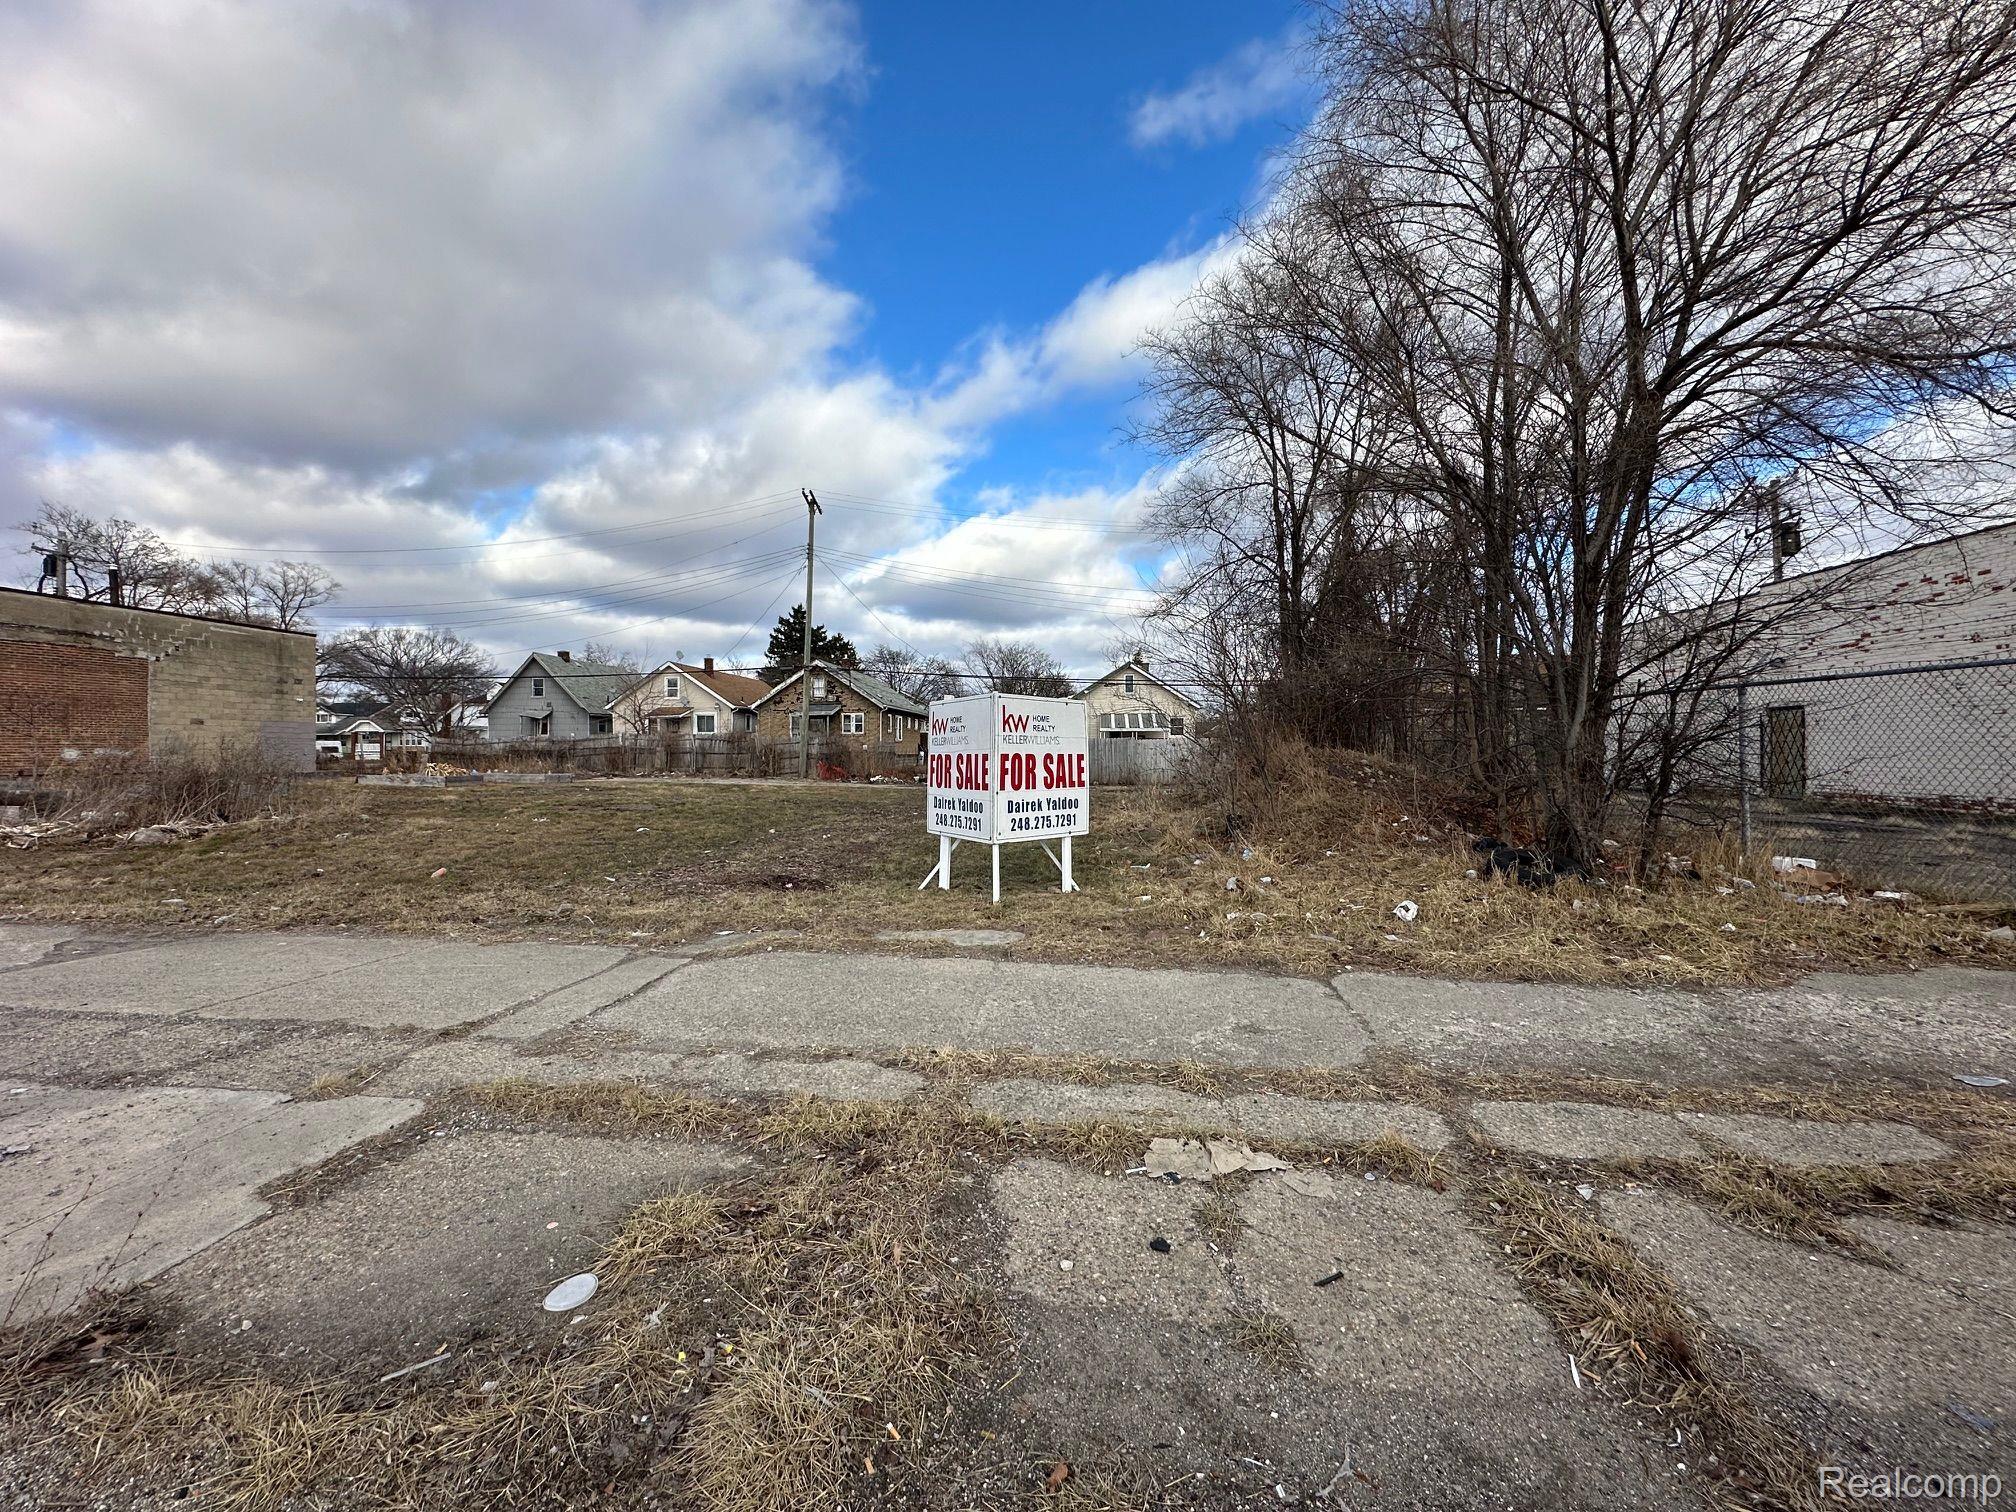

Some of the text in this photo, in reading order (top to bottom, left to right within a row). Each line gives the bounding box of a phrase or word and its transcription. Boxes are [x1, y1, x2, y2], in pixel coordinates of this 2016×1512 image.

[932, 711, 949, 736] kw
[950, 716, 963, 724] HOME
[1002, 704, 1030, 734] kw
[1033, 715, 1050, 723] HOME
[950, 725, 967, 734] REALTY
[1033, 724, 1056, 733] REALTY
[929, 752, 989, 791] FOR SALE
[999, 752, 1086, 791] FOR SALE
[933, 796, 984, 814] Dairek Yaldoo
[1007, 797, 1079, 814] Dairek Yaldoo
[935, 812, 982, 832] 248.275.7291
[1010, 813, 1077, 832] 248.275.7291
